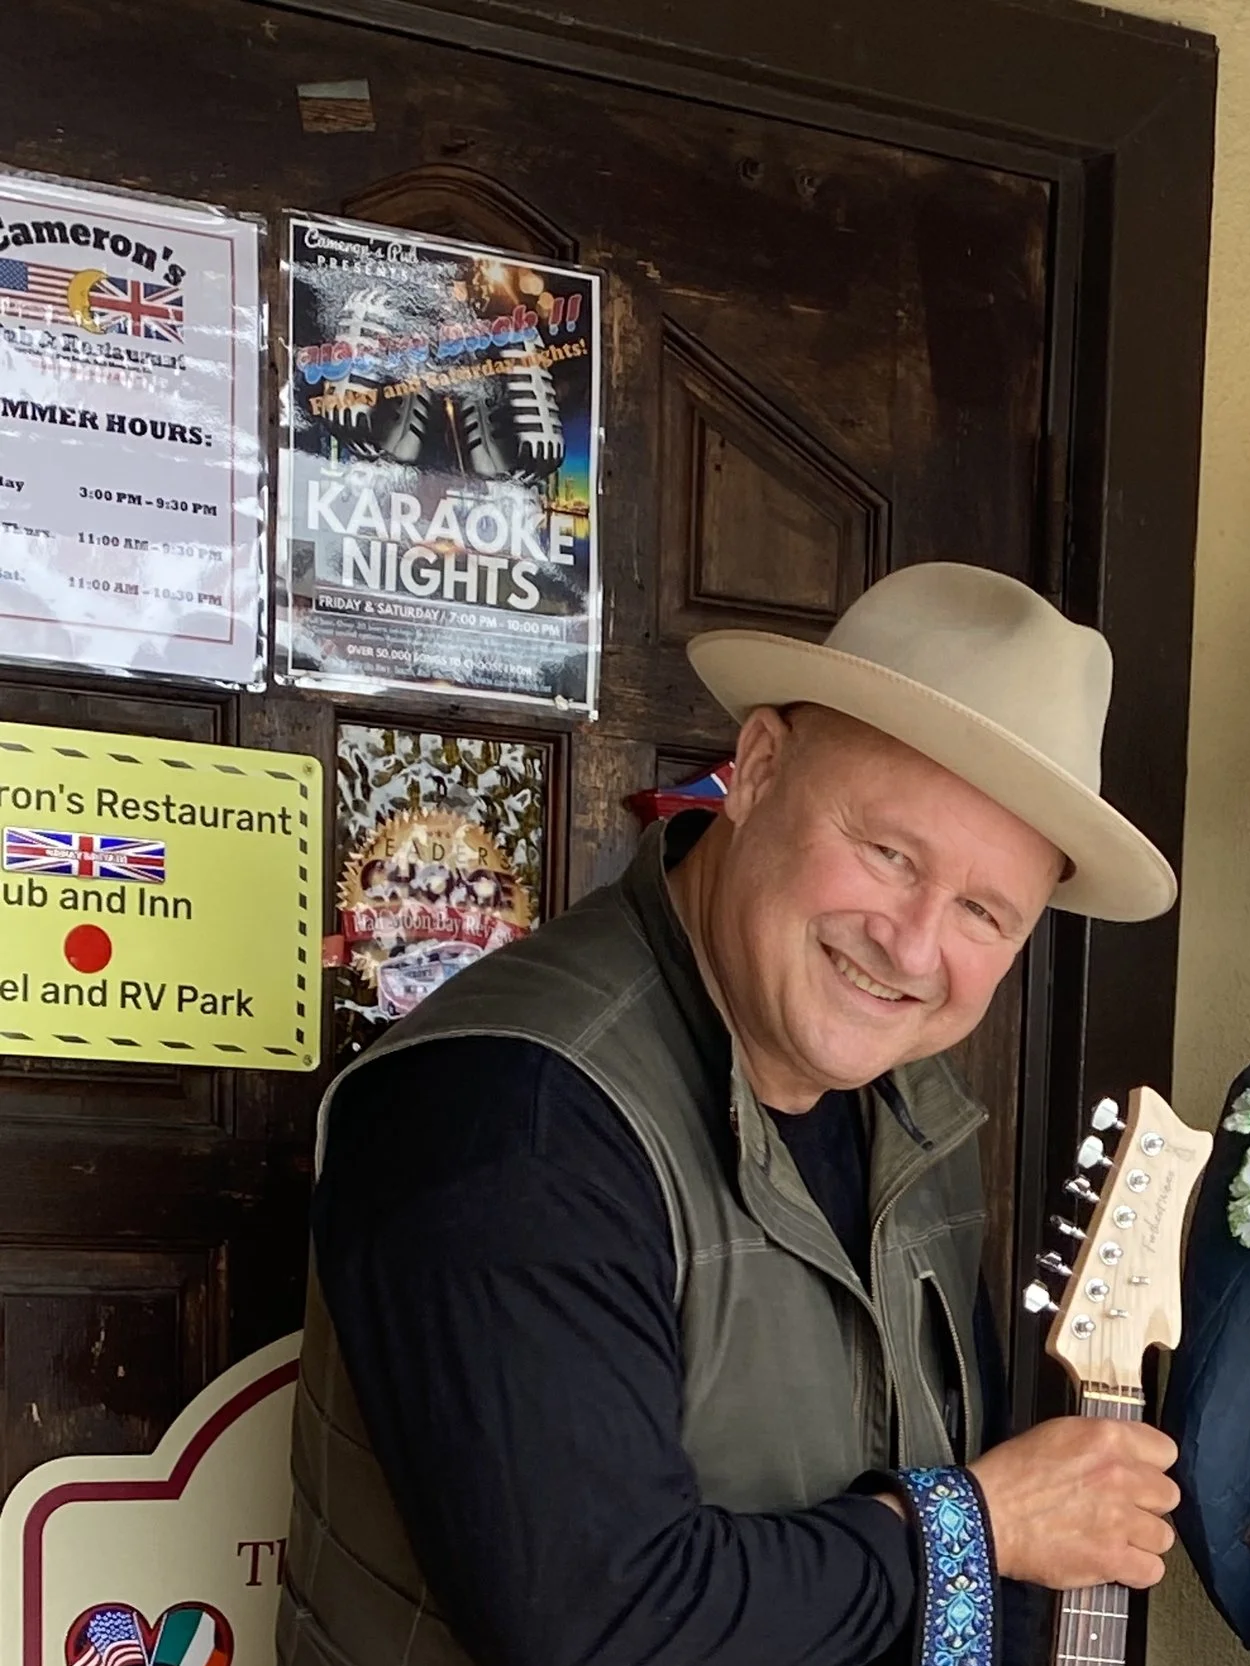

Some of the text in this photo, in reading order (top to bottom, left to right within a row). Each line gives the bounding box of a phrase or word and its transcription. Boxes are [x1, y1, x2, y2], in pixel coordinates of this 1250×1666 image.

[383, 376, 421, 400] and
[106, 412, 213, 447] HOURS:
[79, 486, 112, 502] 3:00
[116, 491, 142, 507] PM
[156, 497, 188, 512] 9:30
[192, 502, 218, 517] PM
[306, 479, 575, 566] KARAOKE
[77, 531, 120, 547] 11:00
[123, 537, 149, 552] AM
[198, 547, 223, 562] PM
[68, 575, 110, 592] 11:00
[113, 581, 140, 596] AM
[153, 586, 193, 602] 10:30
[197, 592, 223, 607] PM
[341, 536, 541, 611] NIGHTS
[318, 595, 561, 638] FRIDAY & SATURDAY 7:00 PM 10:00 PM
[346, 643, 374, 659] OVER
[97, 789, 293, 837] Restaurant
[59, 885, 127, 916] and
[139, 887, 193, 920] Inn
[0, 973, 255, 1019] el and RV Park
